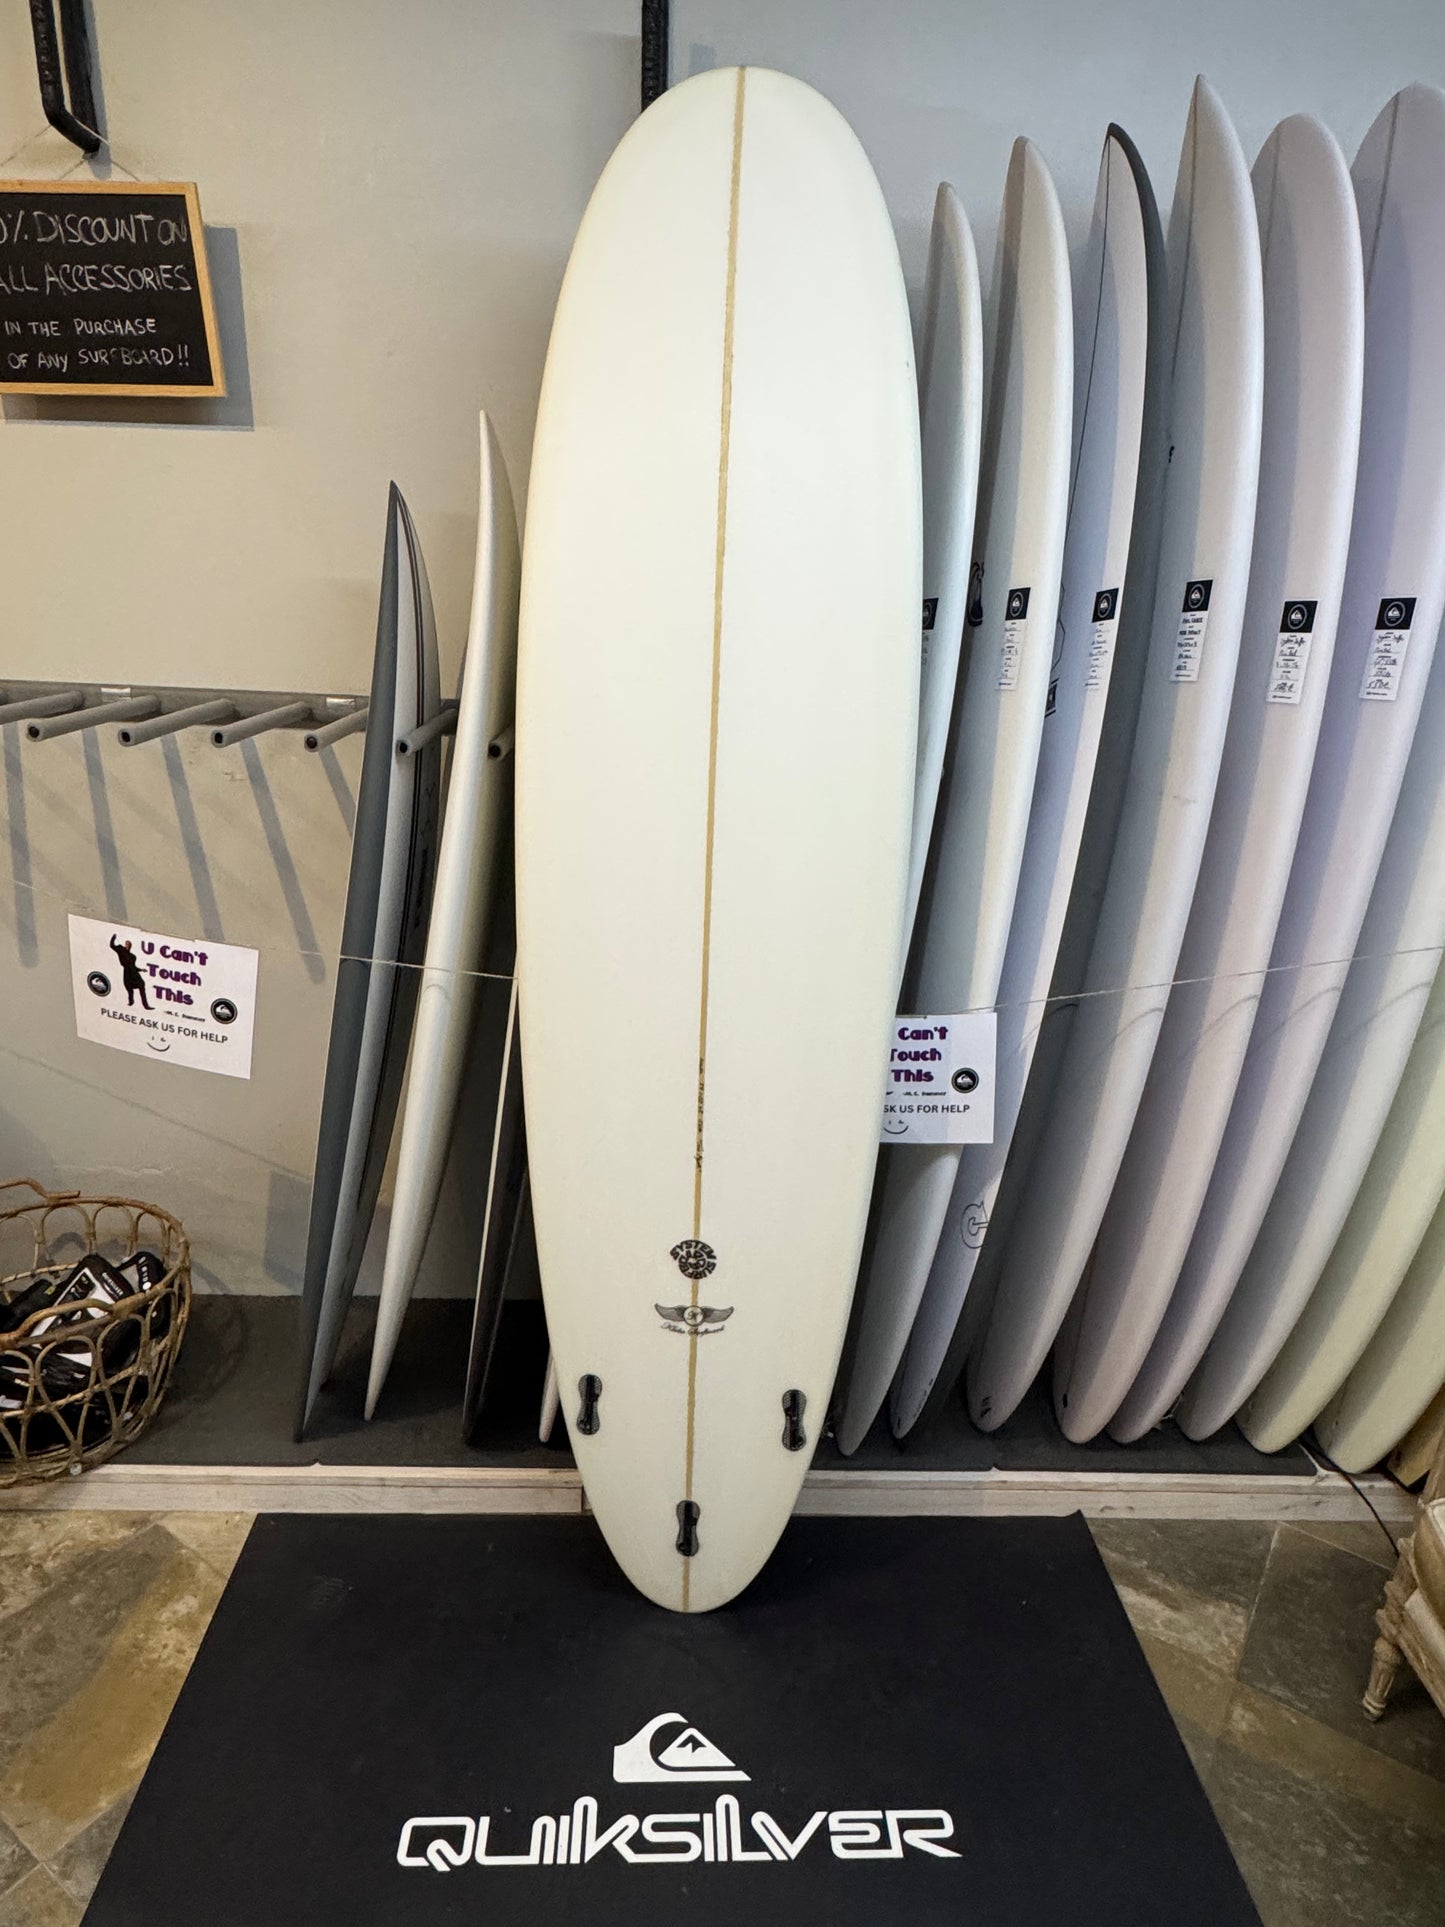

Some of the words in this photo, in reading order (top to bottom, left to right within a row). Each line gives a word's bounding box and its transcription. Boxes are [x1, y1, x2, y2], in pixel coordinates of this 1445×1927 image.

[32, 210, 154, 246] DISCOUNT
[157, 217, 188, 246] ON
[45, 262, 192, 296] ACCESSORIES
[4, 320, 22, 335] IN
[28, 320, 61, 337] THE
[73, 318, 157, 336] PURCHASE
[7, 352, 28, 369] OF
[38, 351, 68, 373] ANY
[141, 940, 155, 956] U
[159, 945, 208, 967] Can't
[146, 962, 201, 987] Touch
[153, 985, 194, 1006] This
[100, 1007, 138, 1025] PLEASE
[139, 1017, 159, 1030] ASK
[160, 1022, 175, 1034] US
[177, 1026, 198, 1039] FOR
[200, 1031, 228, 1044] HELP
[898, 1026, 948, 1041] Can't
[891, 1069, 934, 1083] This
[899, 1104, 914, 1113] US
[917, 1104, 939, 1113] FOR
[941, 1104, 970, 1113] HELP
[396, 1794, 963, 1872] QUIKSILVER
